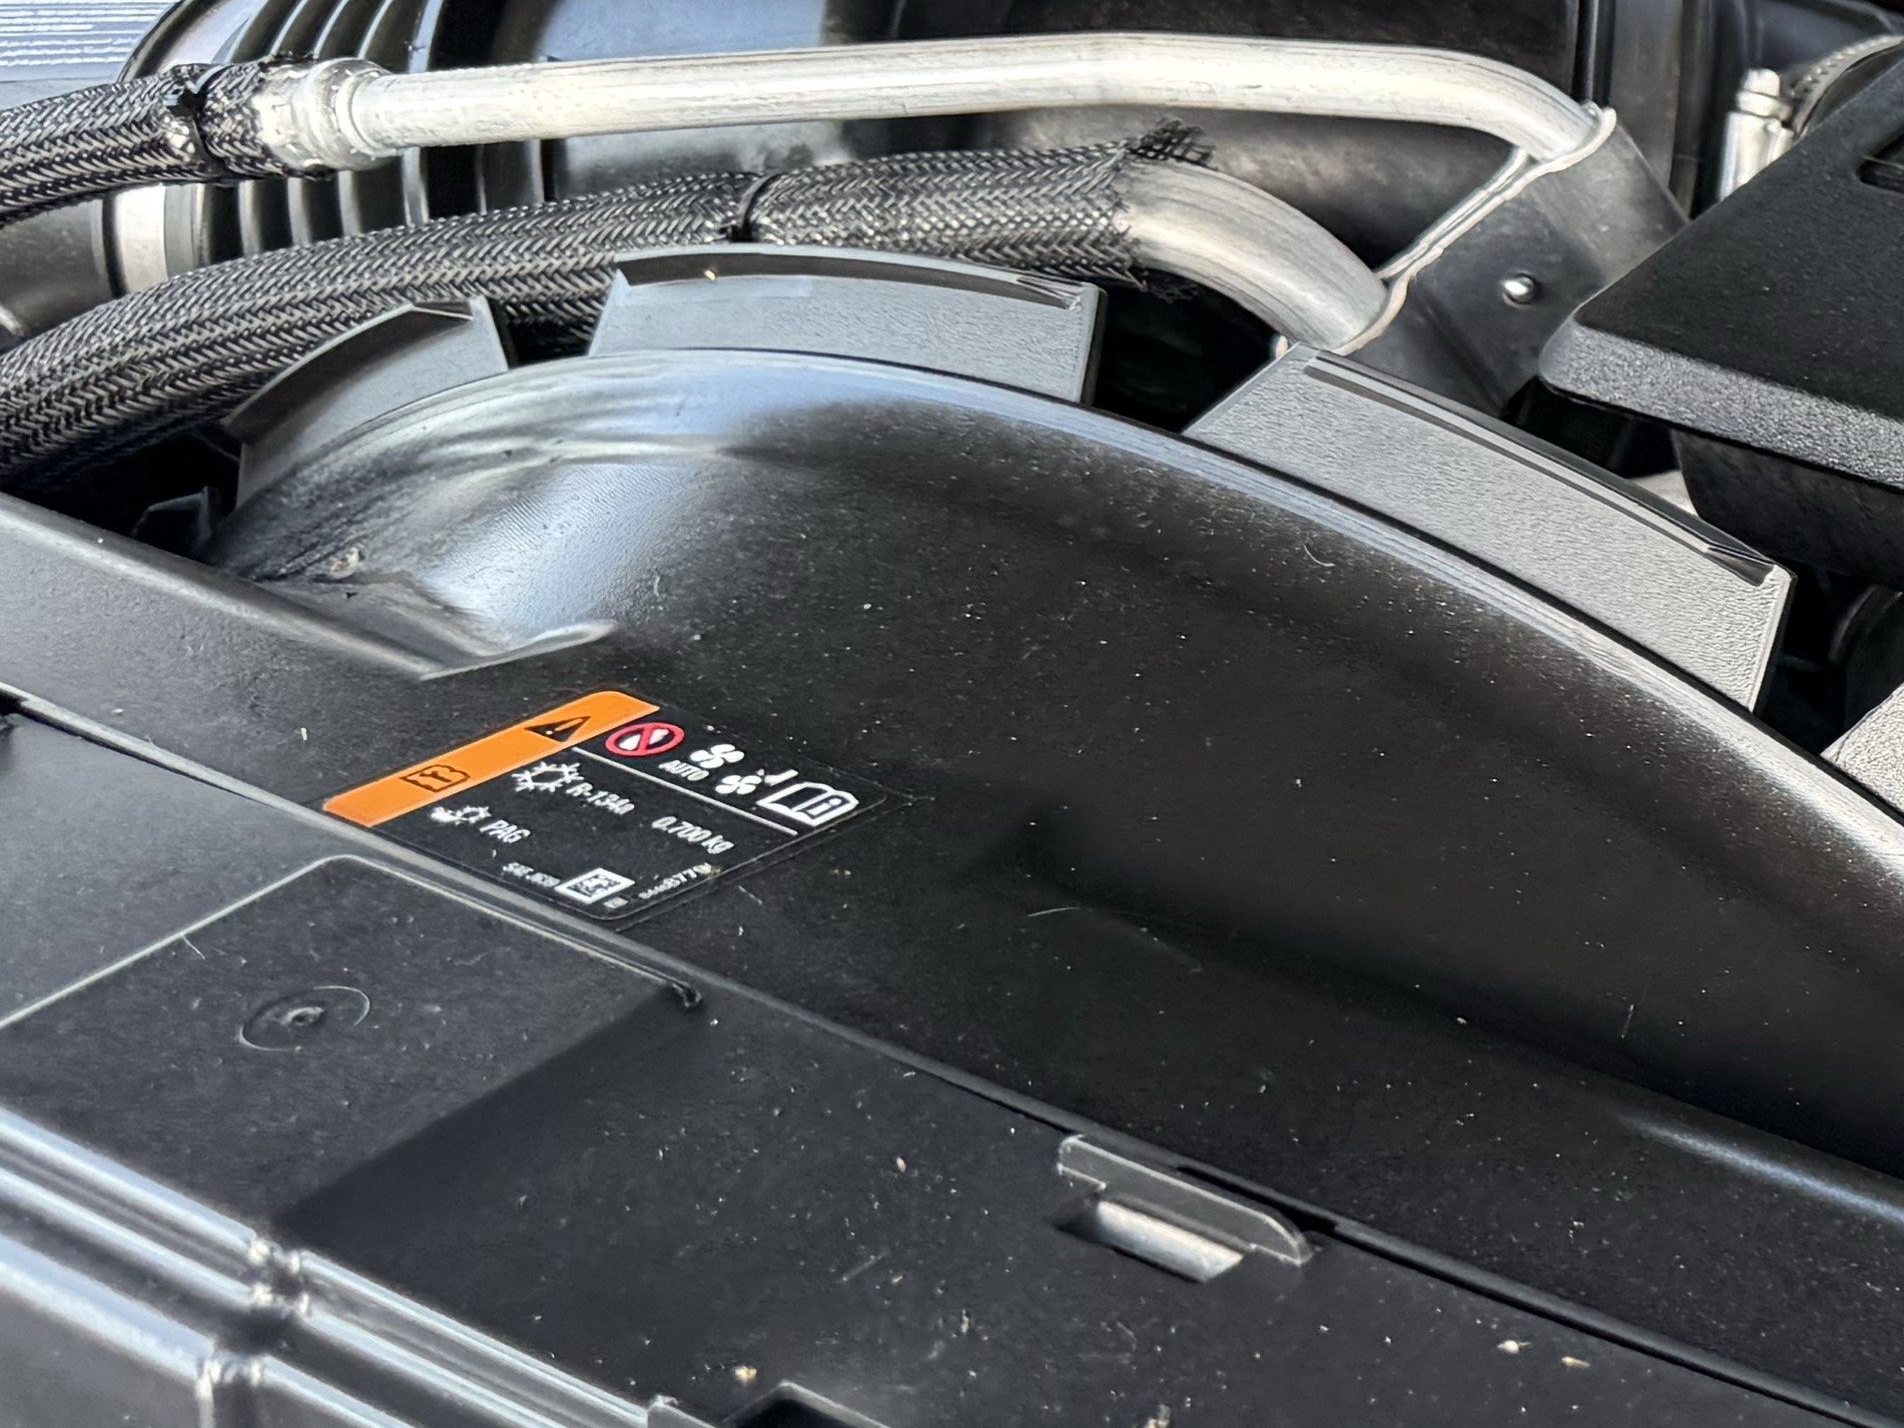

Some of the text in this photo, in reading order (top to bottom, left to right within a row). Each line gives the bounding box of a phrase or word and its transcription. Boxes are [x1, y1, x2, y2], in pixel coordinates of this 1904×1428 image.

[658, 759, 710, 782] AUTO
[566, 782, 735, 855] R-134a 0.700 kg
[479, 820, 531, 843] PAG
